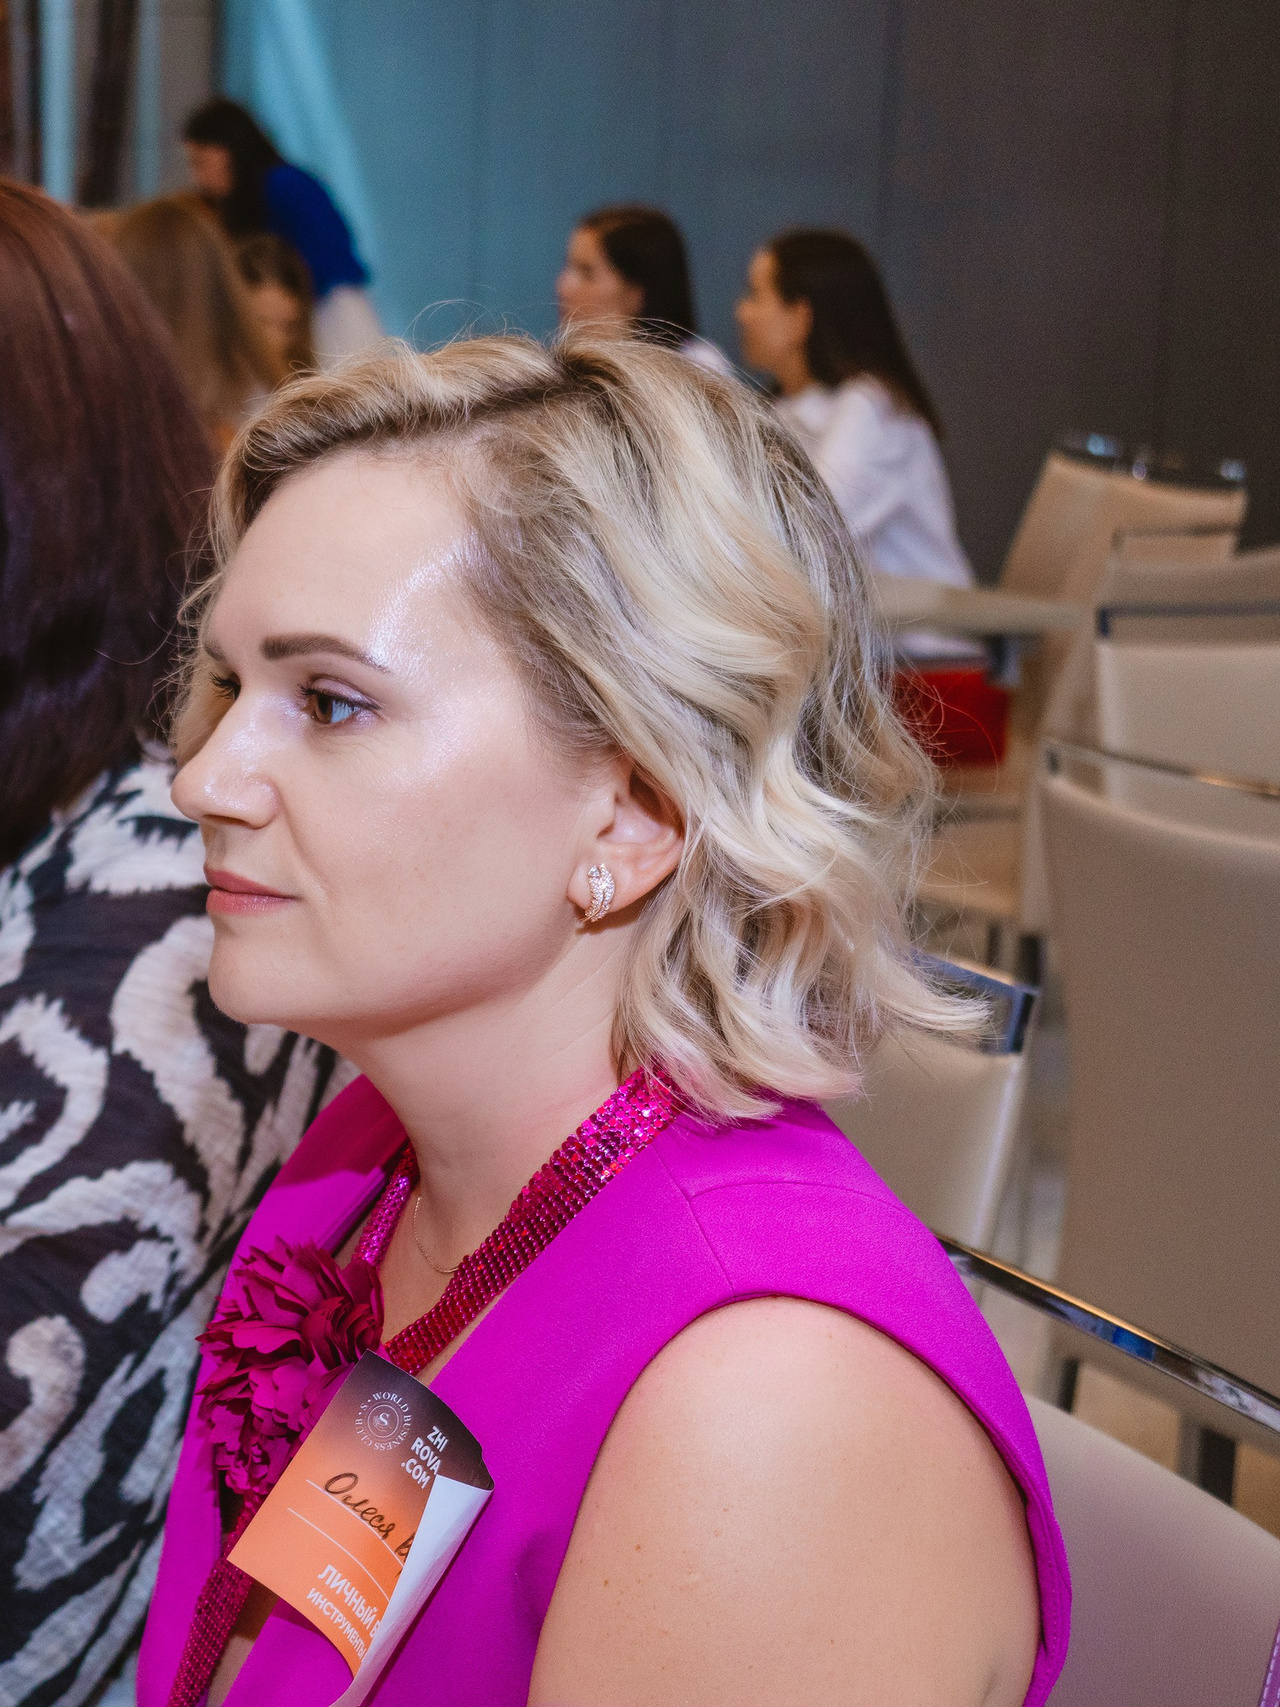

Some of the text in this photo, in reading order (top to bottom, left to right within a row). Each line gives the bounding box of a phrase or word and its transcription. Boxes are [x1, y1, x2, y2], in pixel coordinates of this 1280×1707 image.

[372, 1391, 409, 1413] WORLD
[355, 1418, 373, 1447] CLUB
[373, 1414, 412, 1451] BUSINESS
[426, 1425, 448, 1453] ZHI
[401, 1458, 431, 1490] .COM
[410, 1436, 441, 1476] ROVA
[324, 1472, 396, 1540] Олеся
[317, 1563, 378, 1631] ЛИЧНЫЙ
[306, 1587, 367, 1660] ИНСТРУМЕНТЫ
